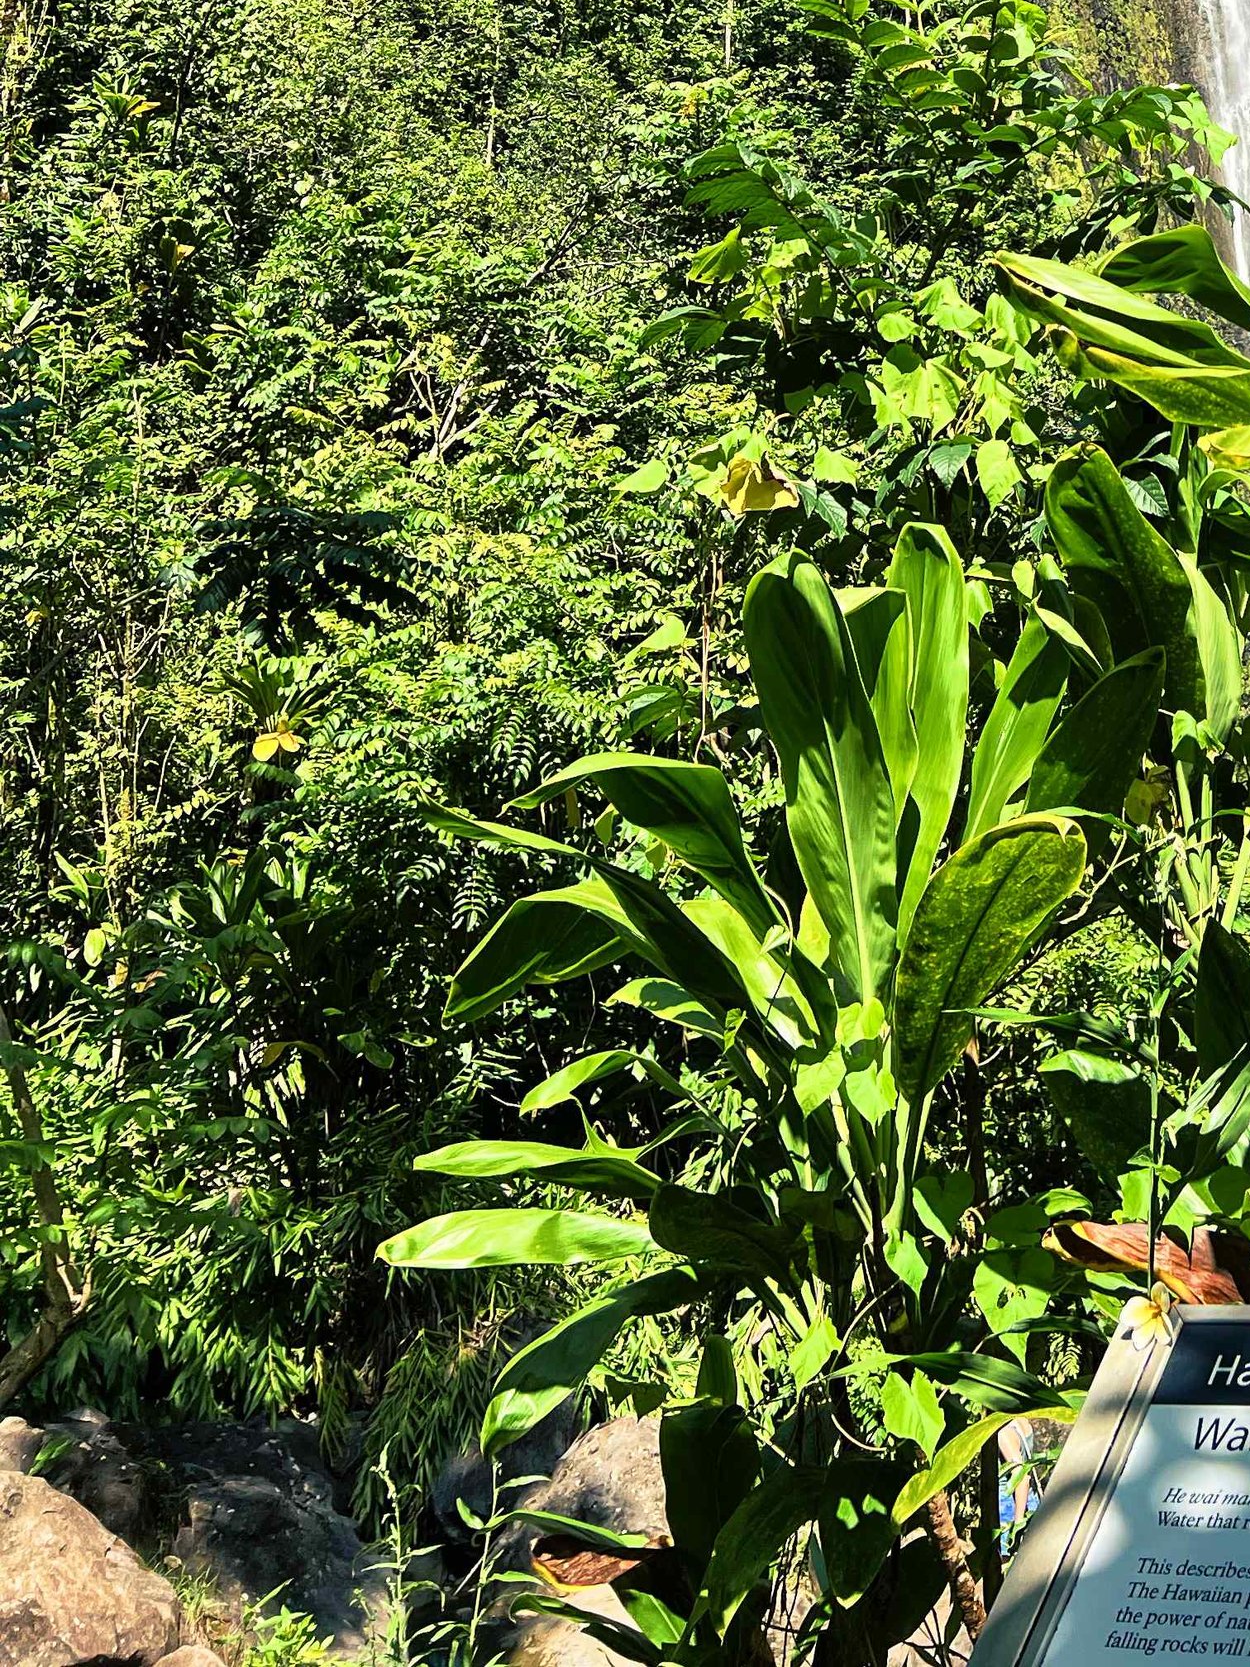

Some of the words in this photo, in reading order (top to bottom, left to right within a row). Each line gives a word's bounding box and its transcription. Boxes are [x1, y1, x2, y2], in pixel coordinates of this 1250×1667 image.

[1162, 1487, 1188, 1504] He
[1188, 1489, 1223, 1506] wai
[1158, 1510, 1204, 1528] Water
[1206, 1512, 1241, 1530] that
[1137, 1557, 1171, 1575] This
[1127, 1582, 1159, 1599] The
[1161, 1584, 1243, 1604] Hawaiian
[1115, 1606, 1143, 1624] the
[1144, 1611, 1201, 1630] power
[1204, 1612, 1225, 1629] of
[1104, 1630, 1159, 1656] falling
[1160, 1636, 1209, 1655] rocks
[1213, 1639, 1246, 1657] will
